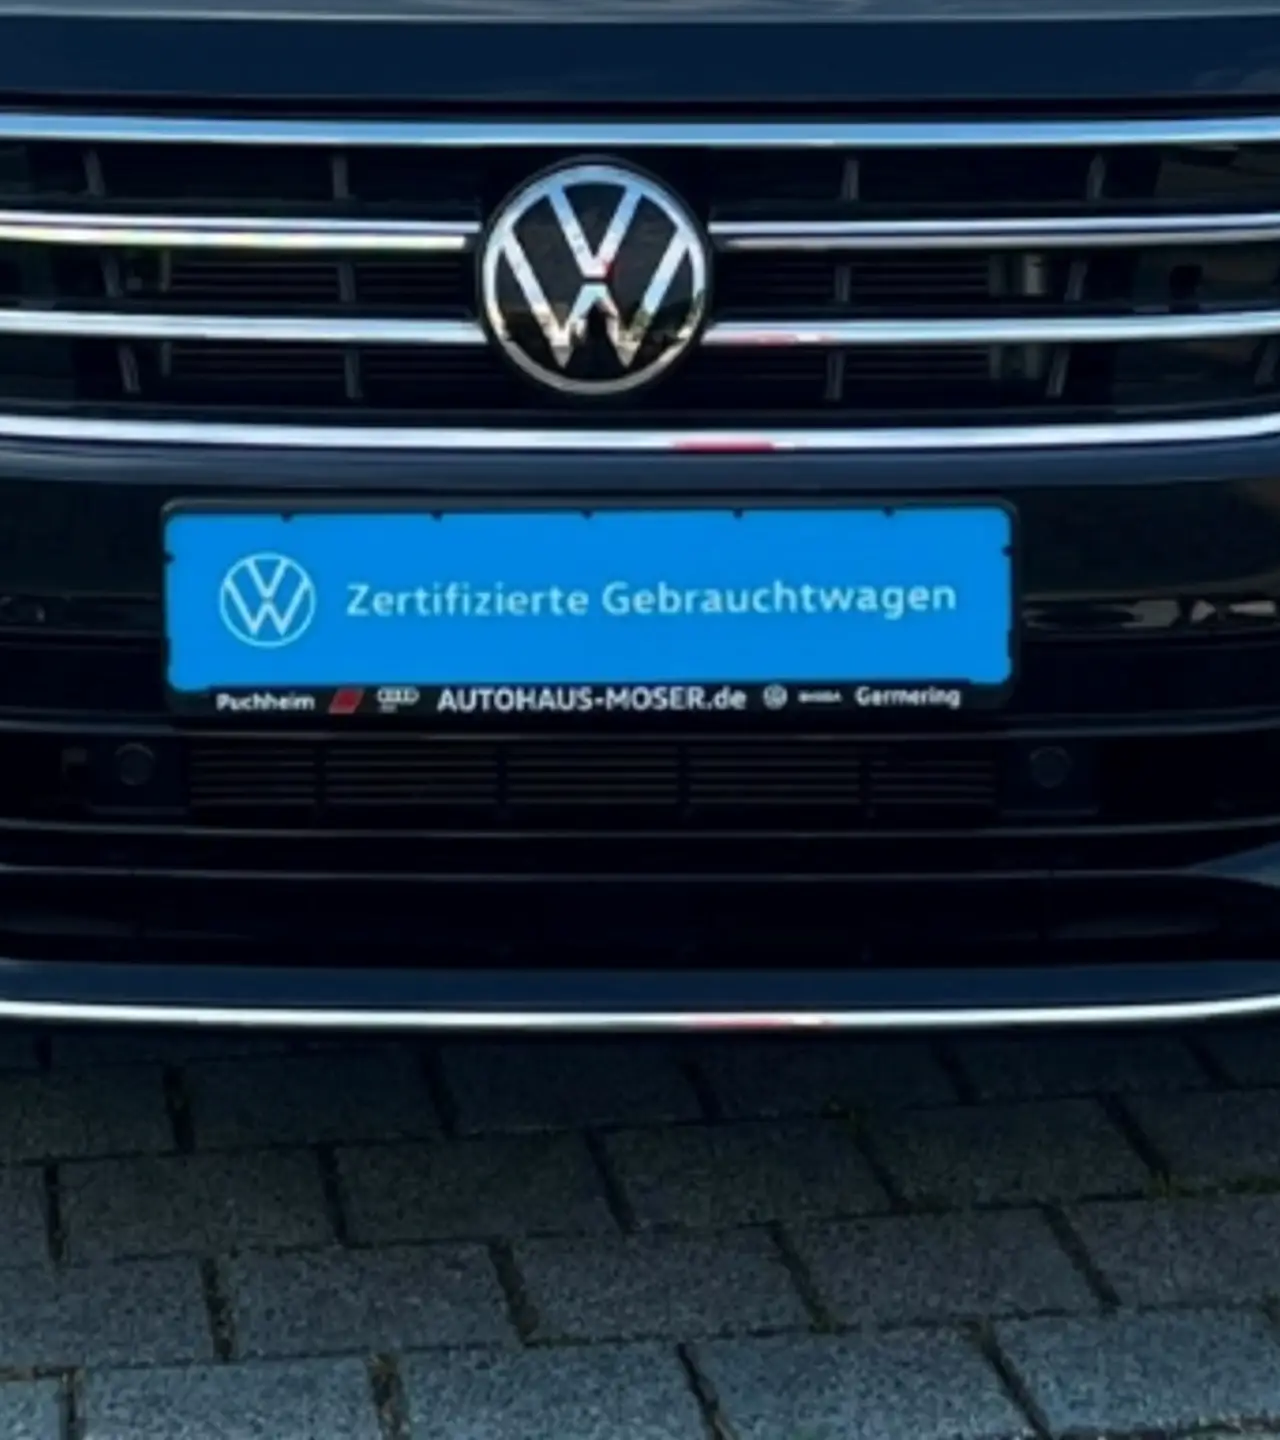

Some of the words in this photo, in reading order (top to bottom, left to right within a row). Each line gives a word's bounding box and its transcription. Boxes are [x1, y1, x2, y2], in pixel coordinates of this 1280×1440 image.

[346, 581, 590, 617] Zertifizierte
[602, 578, 958, 617] Gebrauchtwagen
[215, 691, 316, 712] Puchheim
[436, 686, 748, 713] AUTOHAUS-MOSER.de
